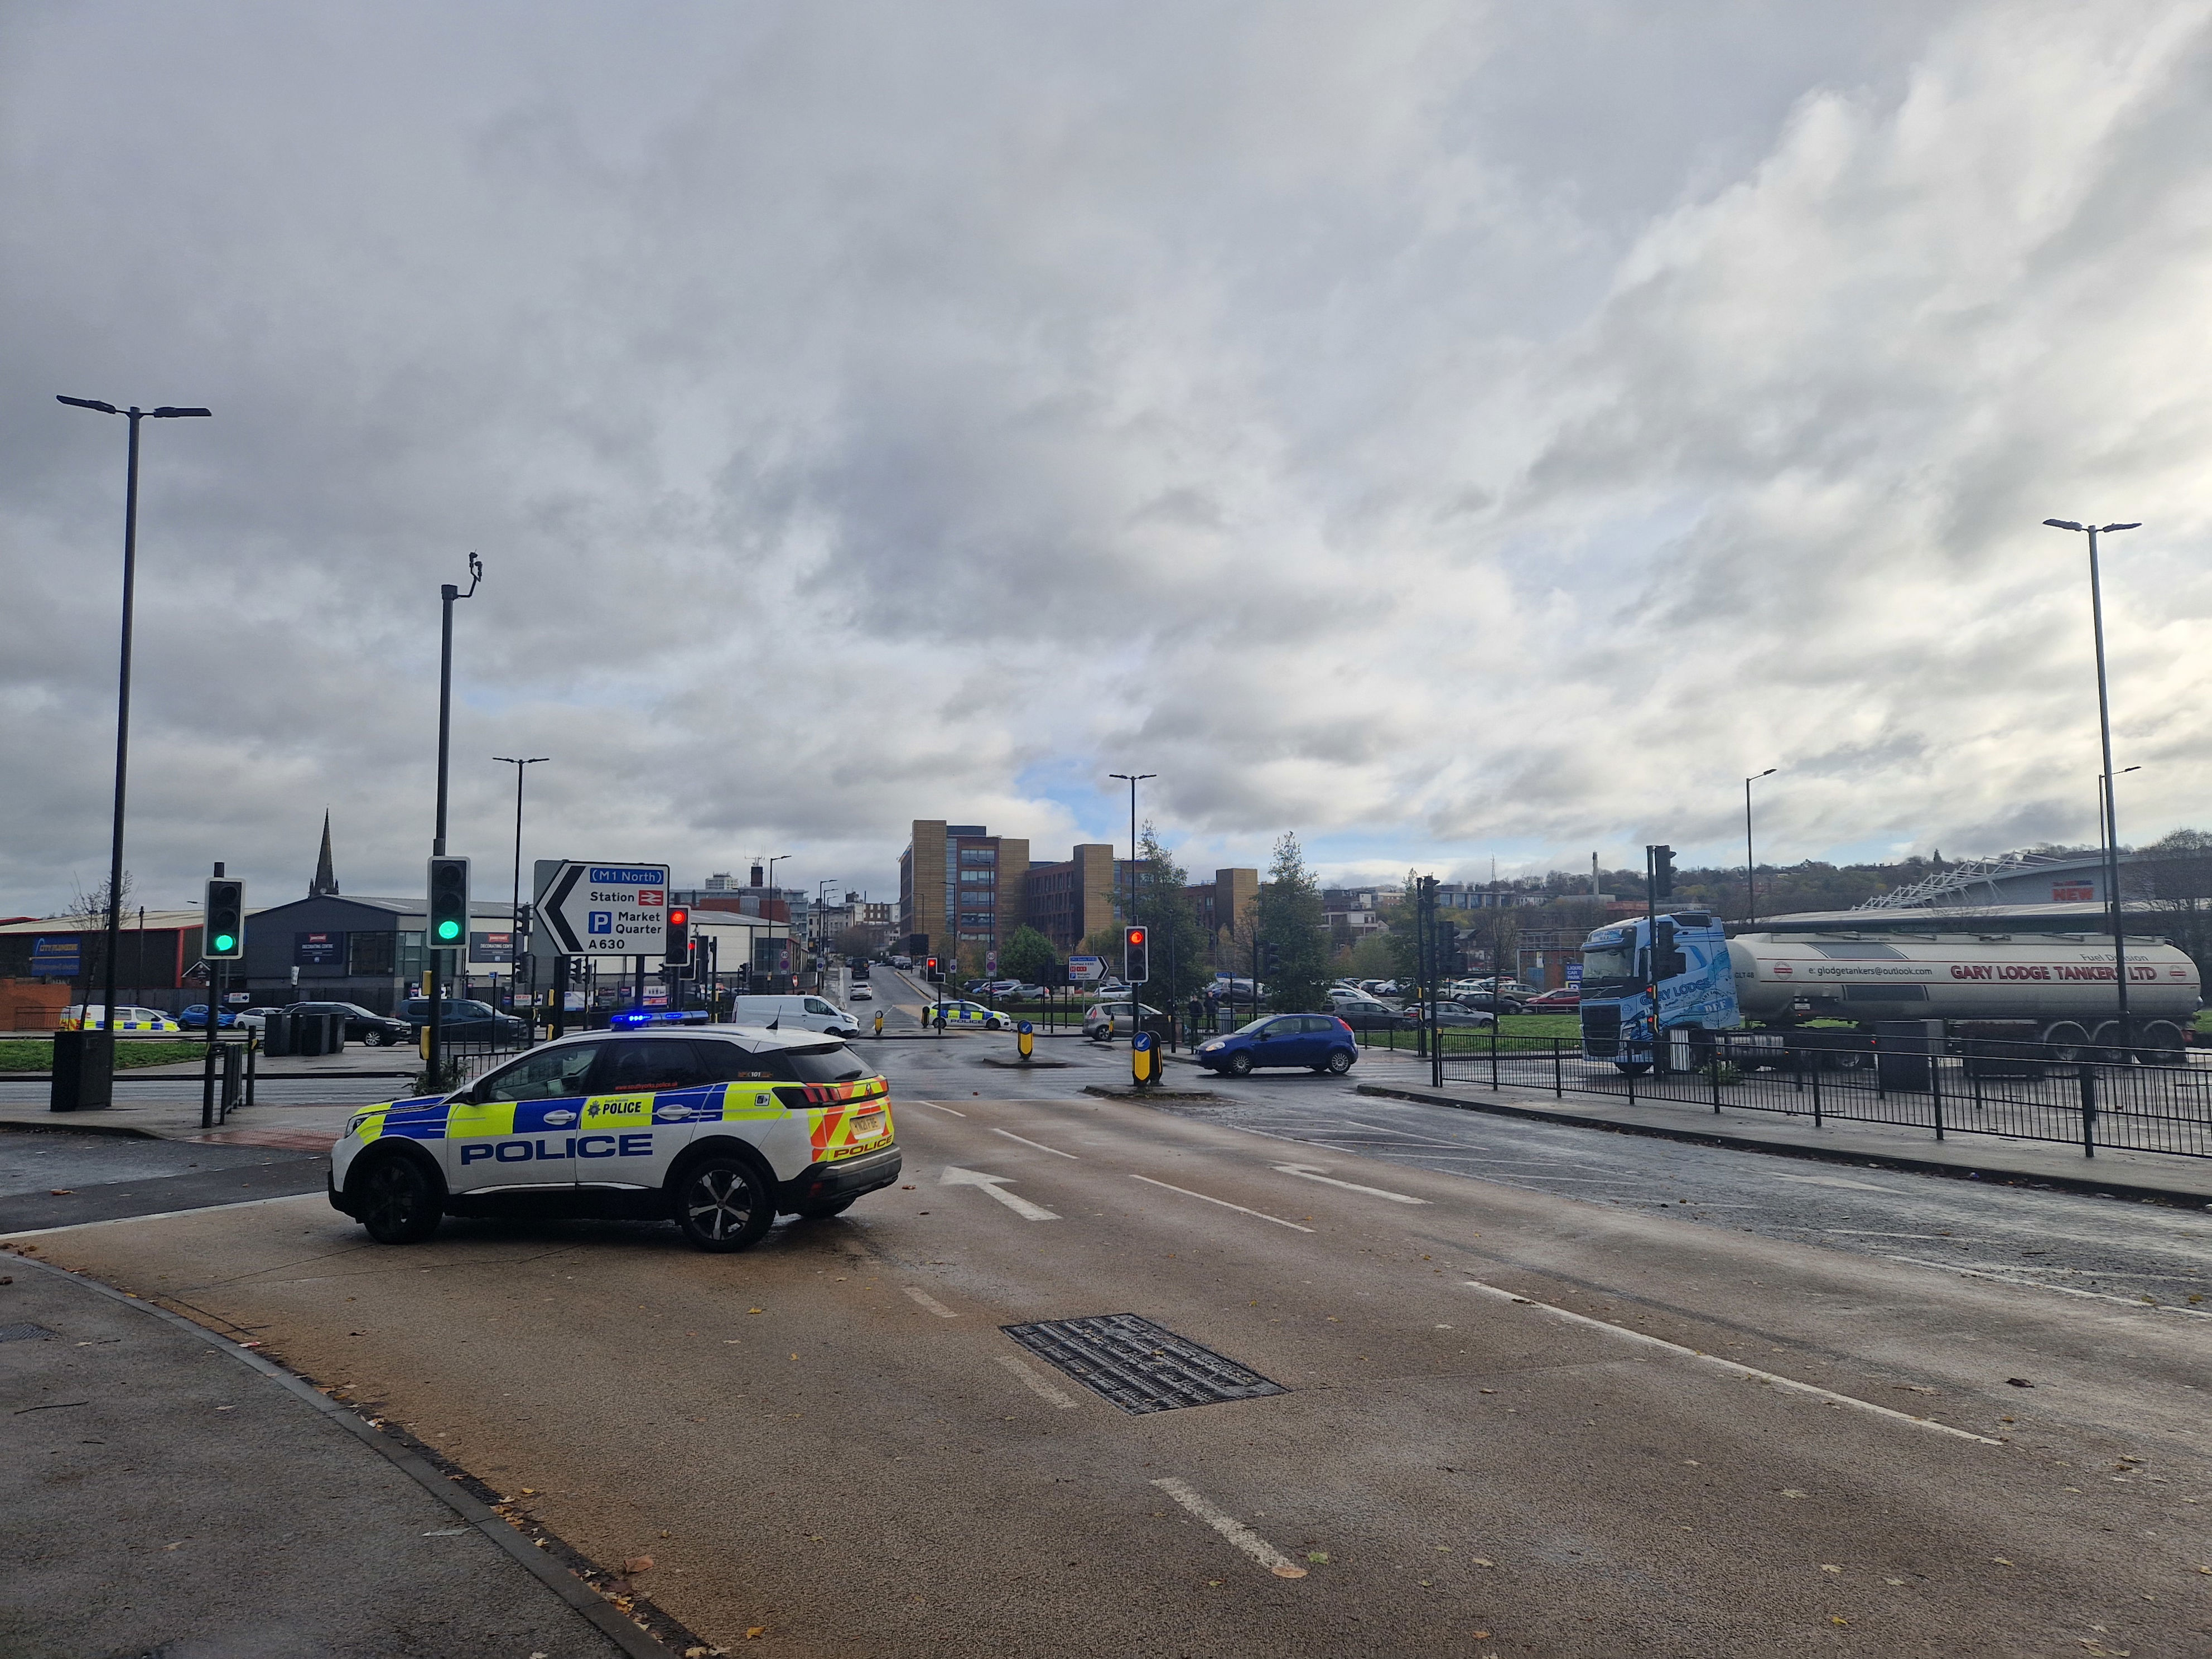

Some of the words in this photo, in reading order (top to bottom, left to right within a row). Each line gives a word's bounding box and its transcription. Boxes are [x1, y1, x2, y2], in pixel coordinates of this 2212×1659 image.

[592, 869, 616, 881] (M1
[621, 871, 662, 883] North)
[590, 891, 635, 901] Station
[2053, 887, 2093, 901] NEW
[594, 914, 609, 932] P
[618, 912, 661, 921] Market
[616, 924, 662, 934] Quarter
[589, 939, 625, 949] A630
[1818, 967, 1933, 976] glodgetankers@outlook.com
[1950, 966, 1993, 980] GARY
[1997, 966, 2051, 980] LODGE
[2127, 967, 2157, 980] LTD
[1640, 988, 1670, 1005] GRY
[1673, 978, 1712, 997] LODGE
[603, 1101, 642, 1115] POLICE
[461, 1134, 653, 1165] POLICE
[833, 1135, 893, 1158] POLICE
